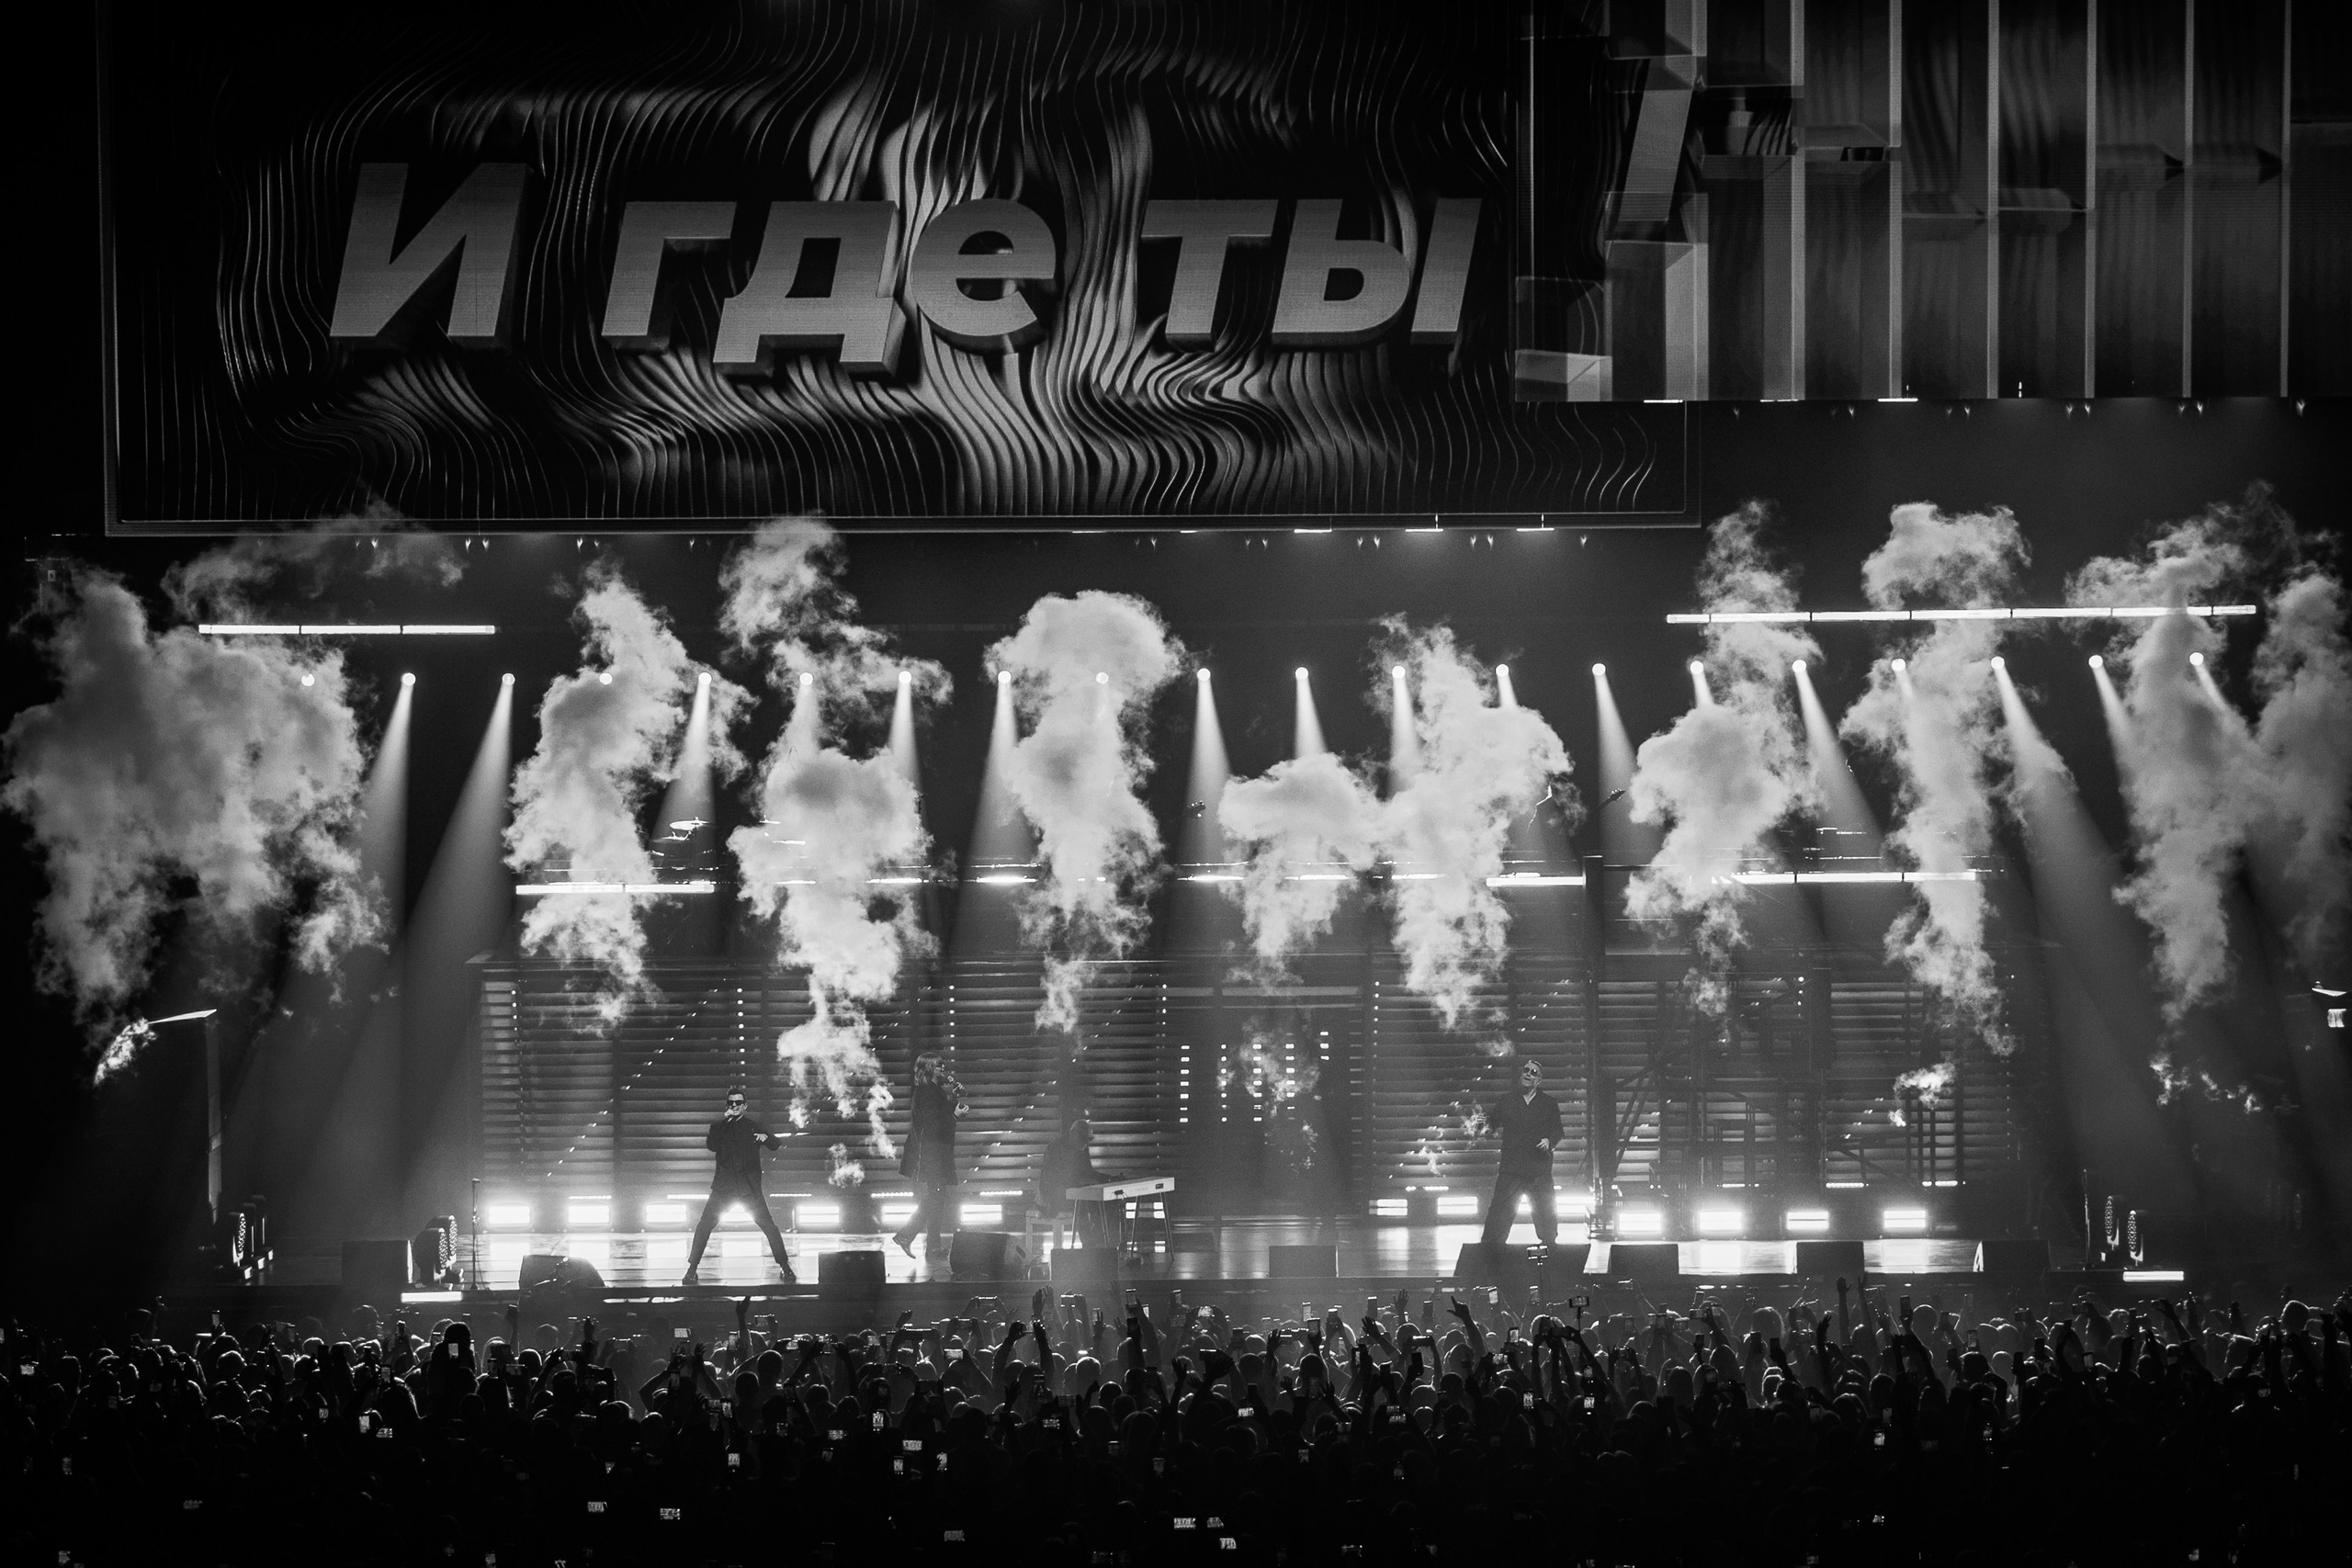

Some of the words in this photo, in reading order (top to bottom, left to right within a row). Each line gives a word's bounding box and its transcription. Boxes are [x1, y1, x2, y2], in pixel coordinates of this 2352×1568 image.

[329, 162, 529, 342] И
[601, 197, 1057, 367] где
[1140, 197, 1483, 339] ты
